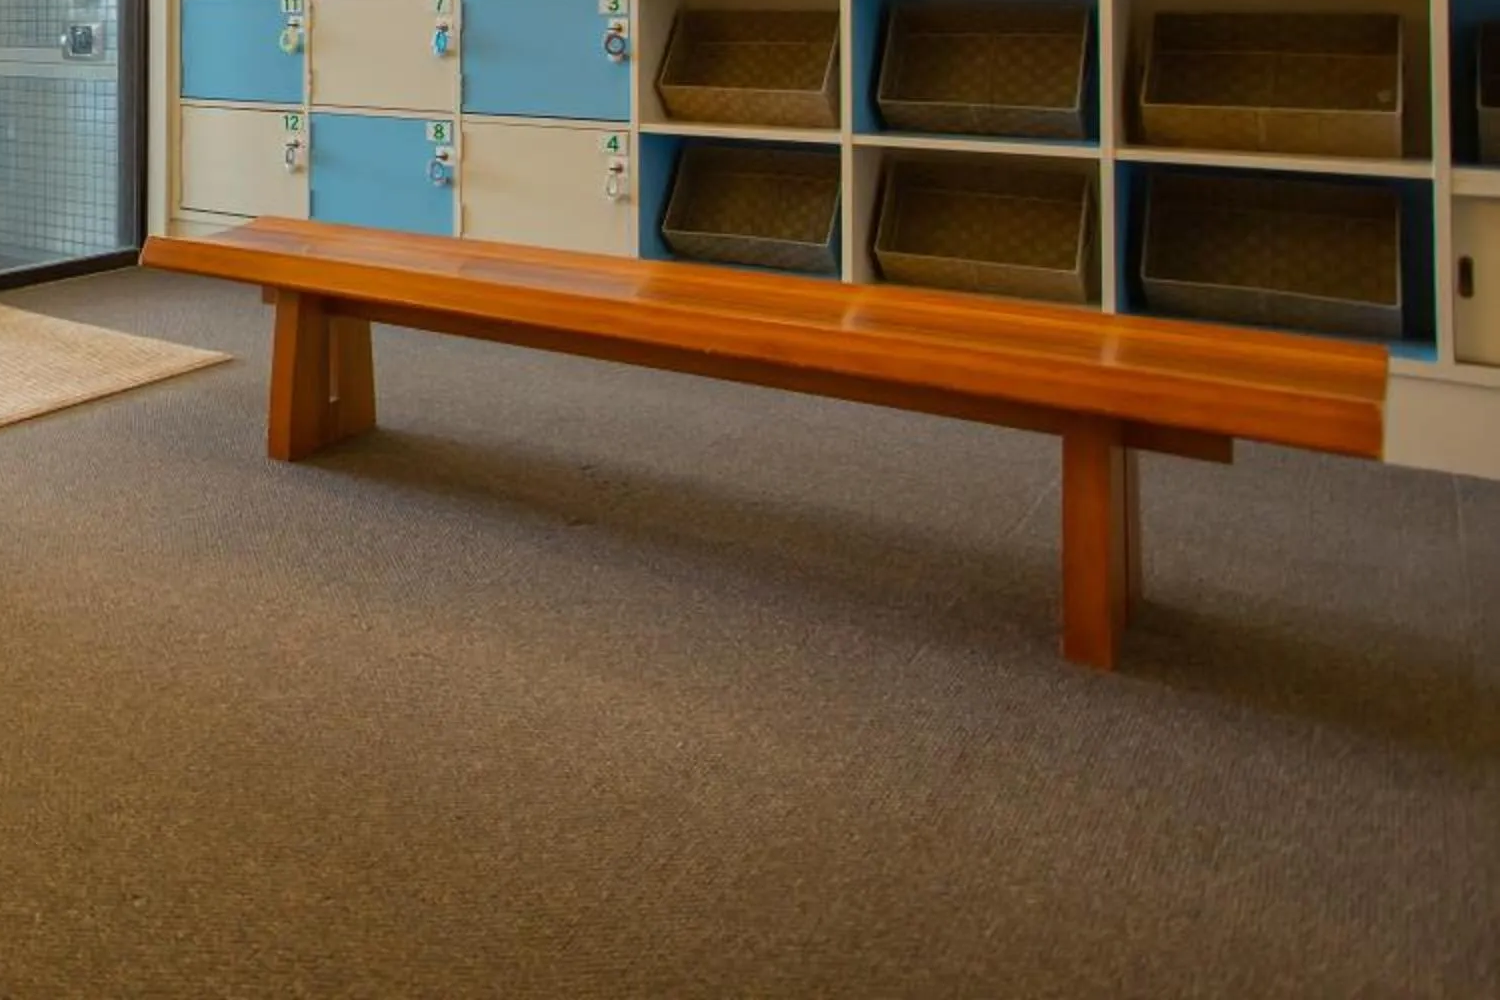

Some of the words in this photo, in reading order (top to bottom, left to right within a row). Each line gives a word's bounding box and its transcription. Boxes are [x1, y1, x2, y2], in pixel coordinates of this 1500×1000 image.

[284, 115, 299, 131] 12
[434, 124, 446, 140] 8
[607, 136, 619, 152] 4
